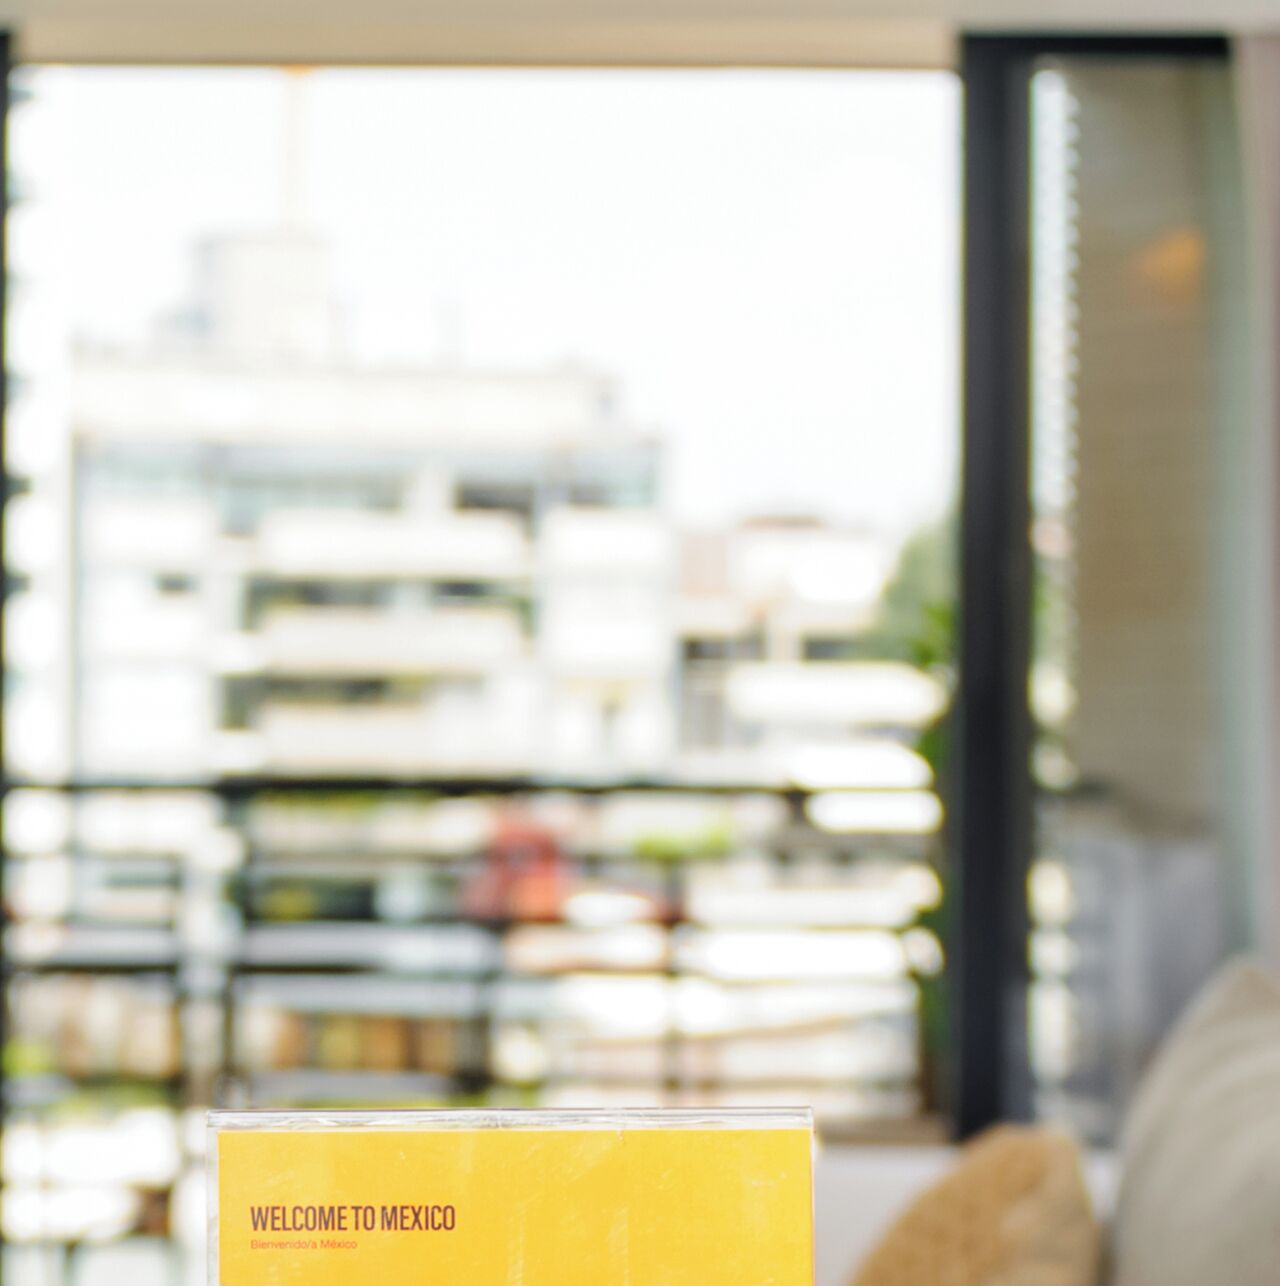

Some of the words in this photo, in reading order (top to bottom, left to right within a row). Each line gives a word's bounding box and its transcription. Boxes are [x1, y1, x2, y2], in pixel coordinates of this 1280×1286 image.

[251, 1206, 348, 1231] WELCOME
[351, 1205, 375, 1231] TO
[381, 1205, 455, 1231] MEXICO
[320, 1239, 357, 1249] México
